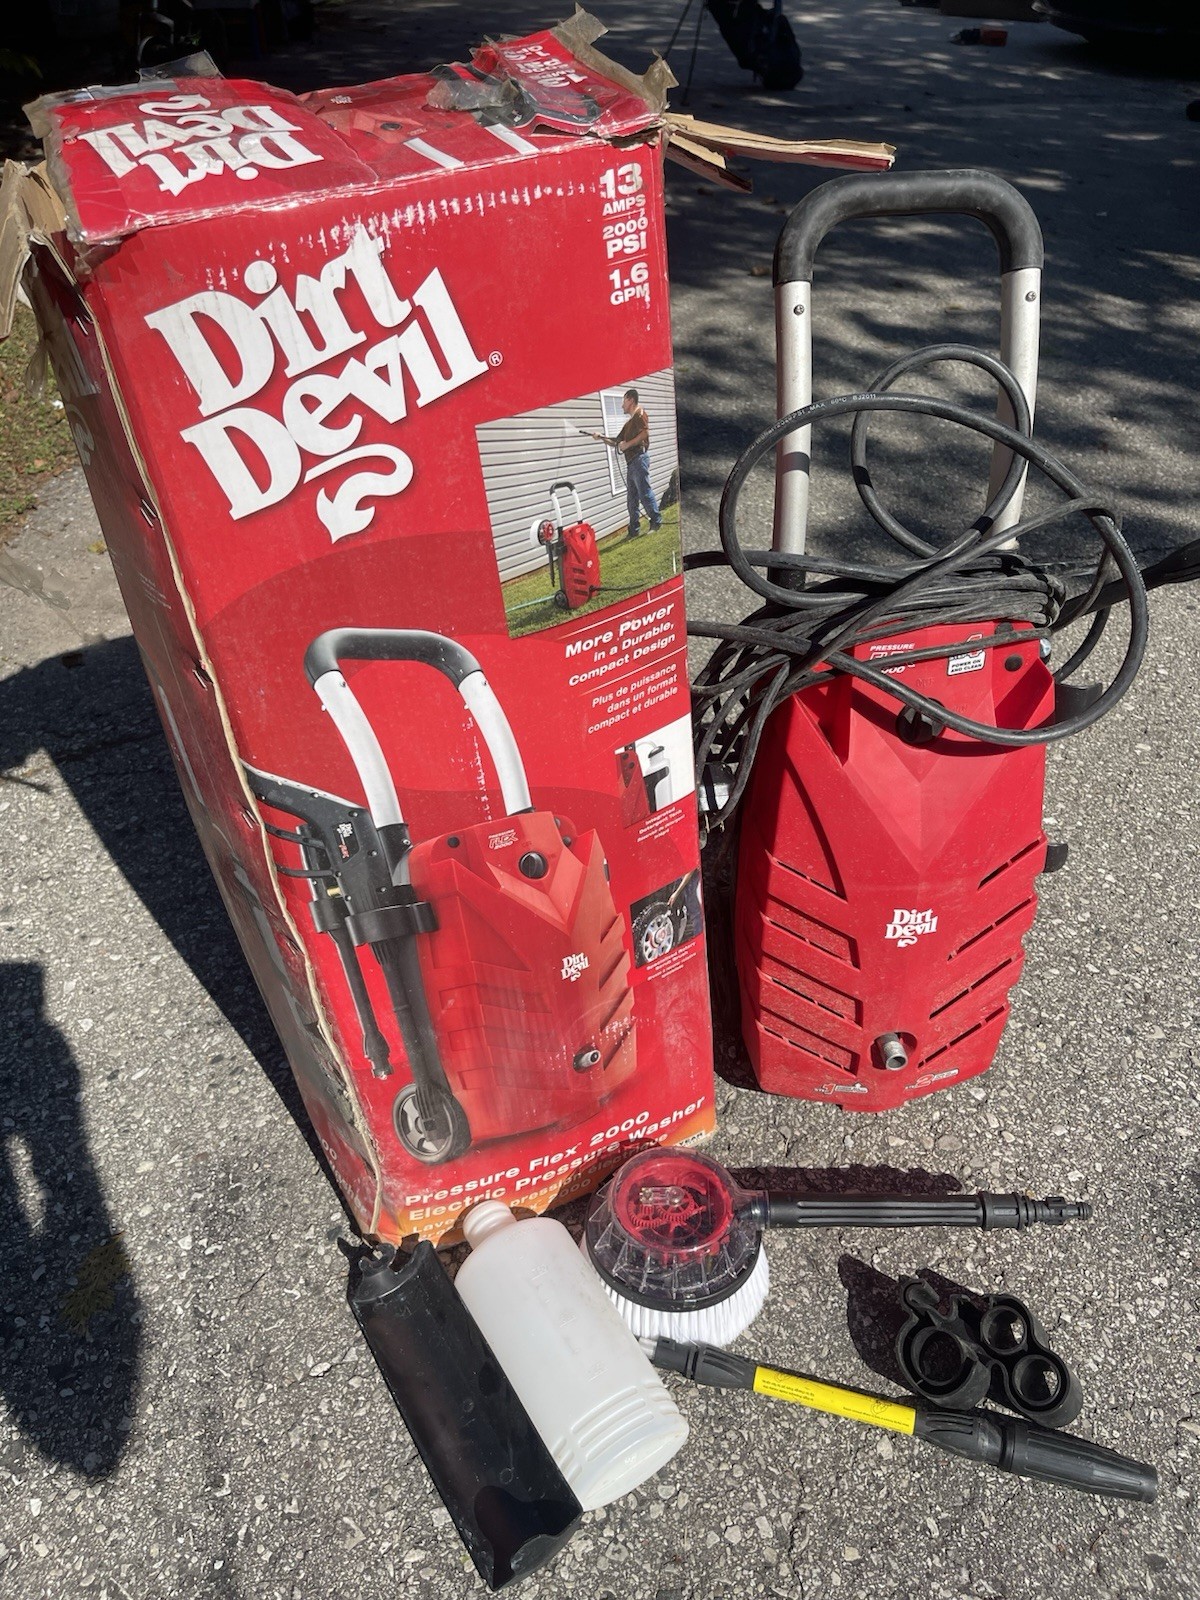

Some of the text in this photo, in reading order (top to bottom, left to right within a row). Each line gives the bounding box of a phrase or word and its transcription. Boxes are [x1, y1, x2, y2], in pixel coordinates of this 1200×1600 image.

[77, 105, 303, 178] Devil
[138, 131, 324, 197] Dirt
[600, 163, 643, 199] 13
[602, 194, 646, 216] AMPS
[603, 217, 648, 239] 2000
[606, 231, 647, 259] PSI
[609, 262, 649, 289] 1.6
[610, 283, 650, 305] GPM
[145, 223, 413, 417] Dirt
[179, 267, 489, 521] Devil
[565, 603, 675, 658] More Power
[593, 621, 675, 662] in a Durable,
[869, 643, 916, 652] PRESSURE
[568, 633, 676, 687] Compact Design
[951, 660, 971, 669] POWER
[963, 663, 982, 671] CLEAN
[591, 663, 677, 708] Plus de puissance
[607, 673, 678, 713] dans un format
[588, 686, 678, 734] compact et durable
[884, 915, 939, 940] Devil
[891, 908, 934, 924] Dirt
[560, 956, 591, 980] Devil
[561, 952, 584, 968] Dirt
[405, 1110, 650, 1206] Pressure Flex 2000
[409, 1096, 705, 1221] Electric Pressure Washer
[510, 1171, 582, 1208] pression
